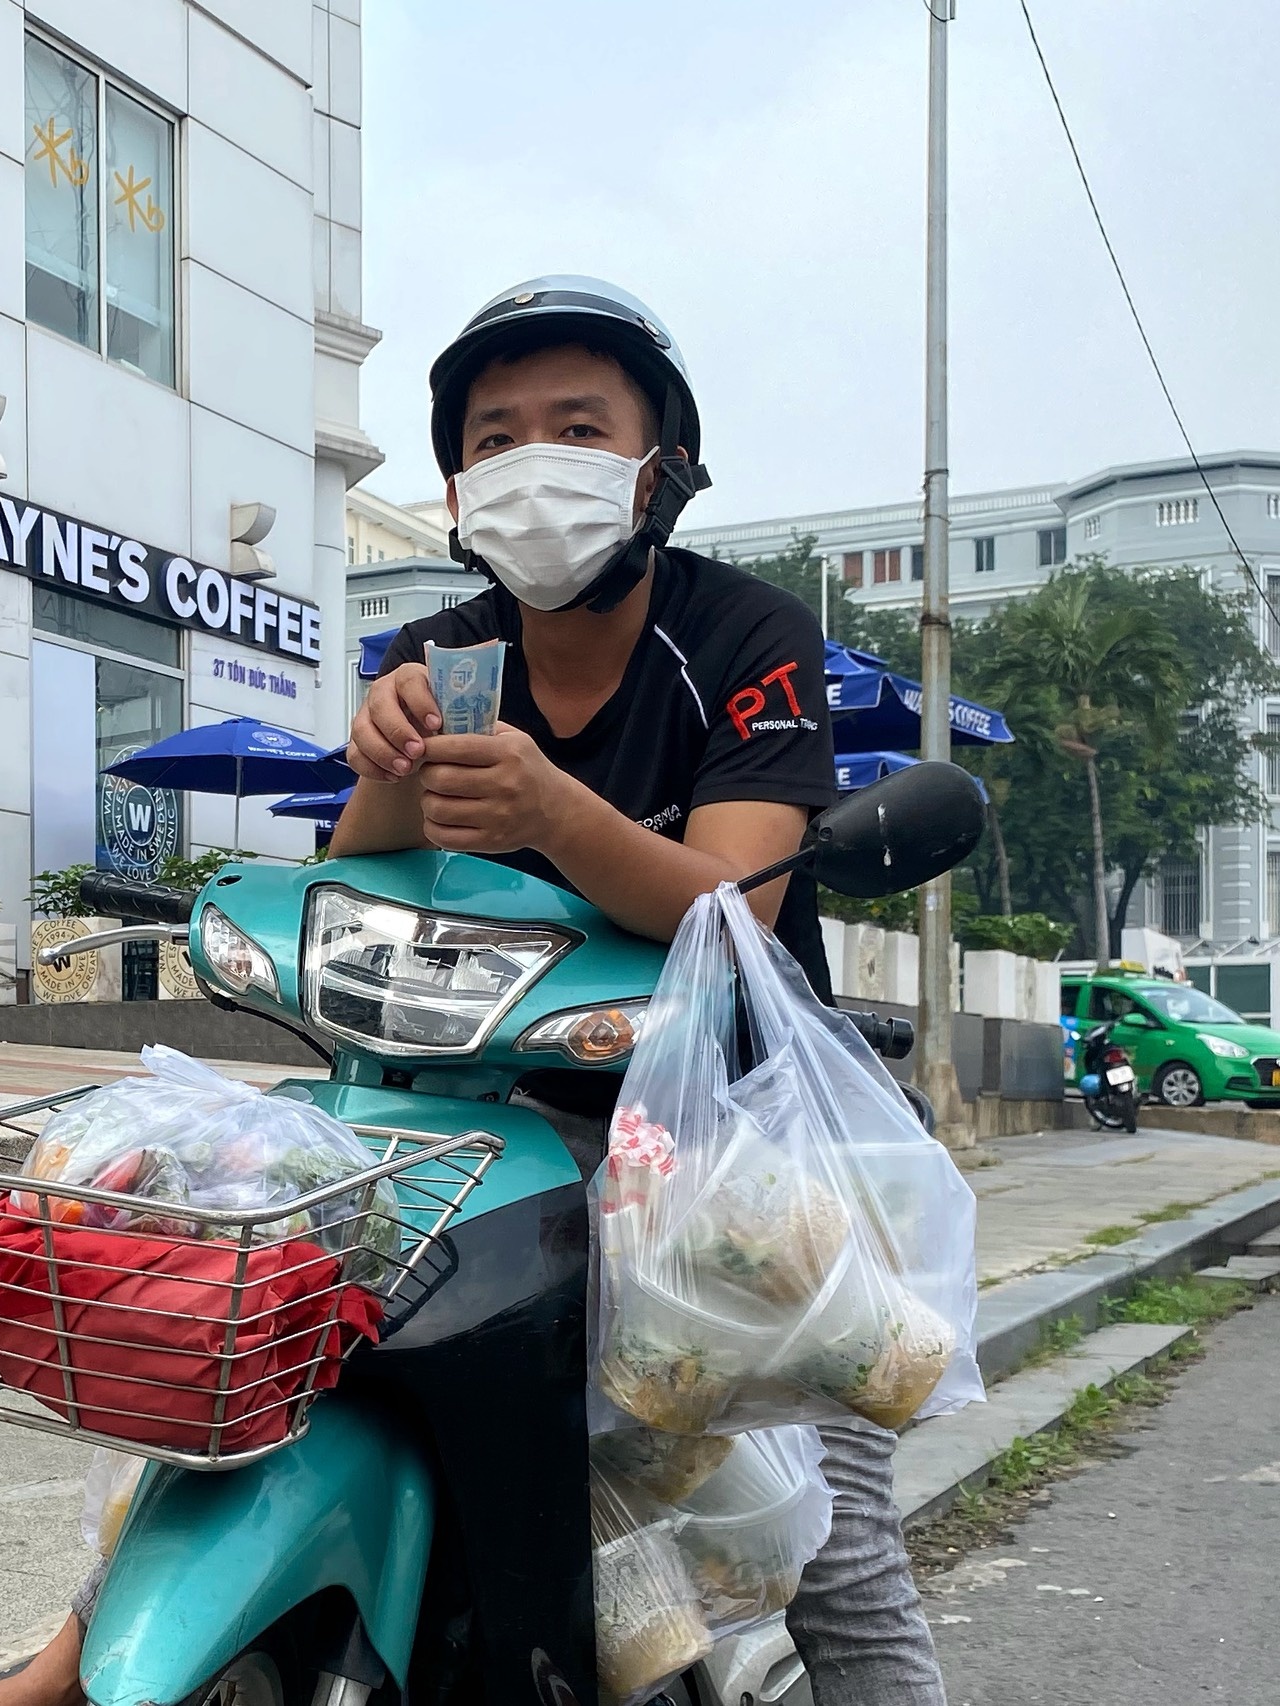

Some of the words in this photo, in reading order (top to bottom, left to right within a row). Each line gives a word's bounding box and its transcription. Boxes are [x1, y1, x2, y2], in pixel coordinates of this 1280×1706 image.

[165, 557, 320, 661] COFFEE
[213, 658, 225, 678] 37
[727, 661, 801, 740] PT
[751, 720, 798, 731] PERSONAL
[955, 704, 992, 735] COFFEE
[115, 814, 135, 857] MADE
[136, 848, 147, 861] IN
[149, 791, 166, 856] SWEDEN
[128, 802, 152, 832] W
[112, 842, 125, 868] WE
[127, 864, 151, 881] LOVE
[46, 931, 66, 944] 1994
[169, 946, 177, 958] ES
[159, 940, 167, 973] WAYN
[40, 971, 61, 990] MADE
[65, 980, 75, 989] IN
[43, 990, 56, 1002] WE
[82, 950, 96, 990] ORGAN
[171, 965, 194, 986] MADE
[173, 985, 187, 998] WE
